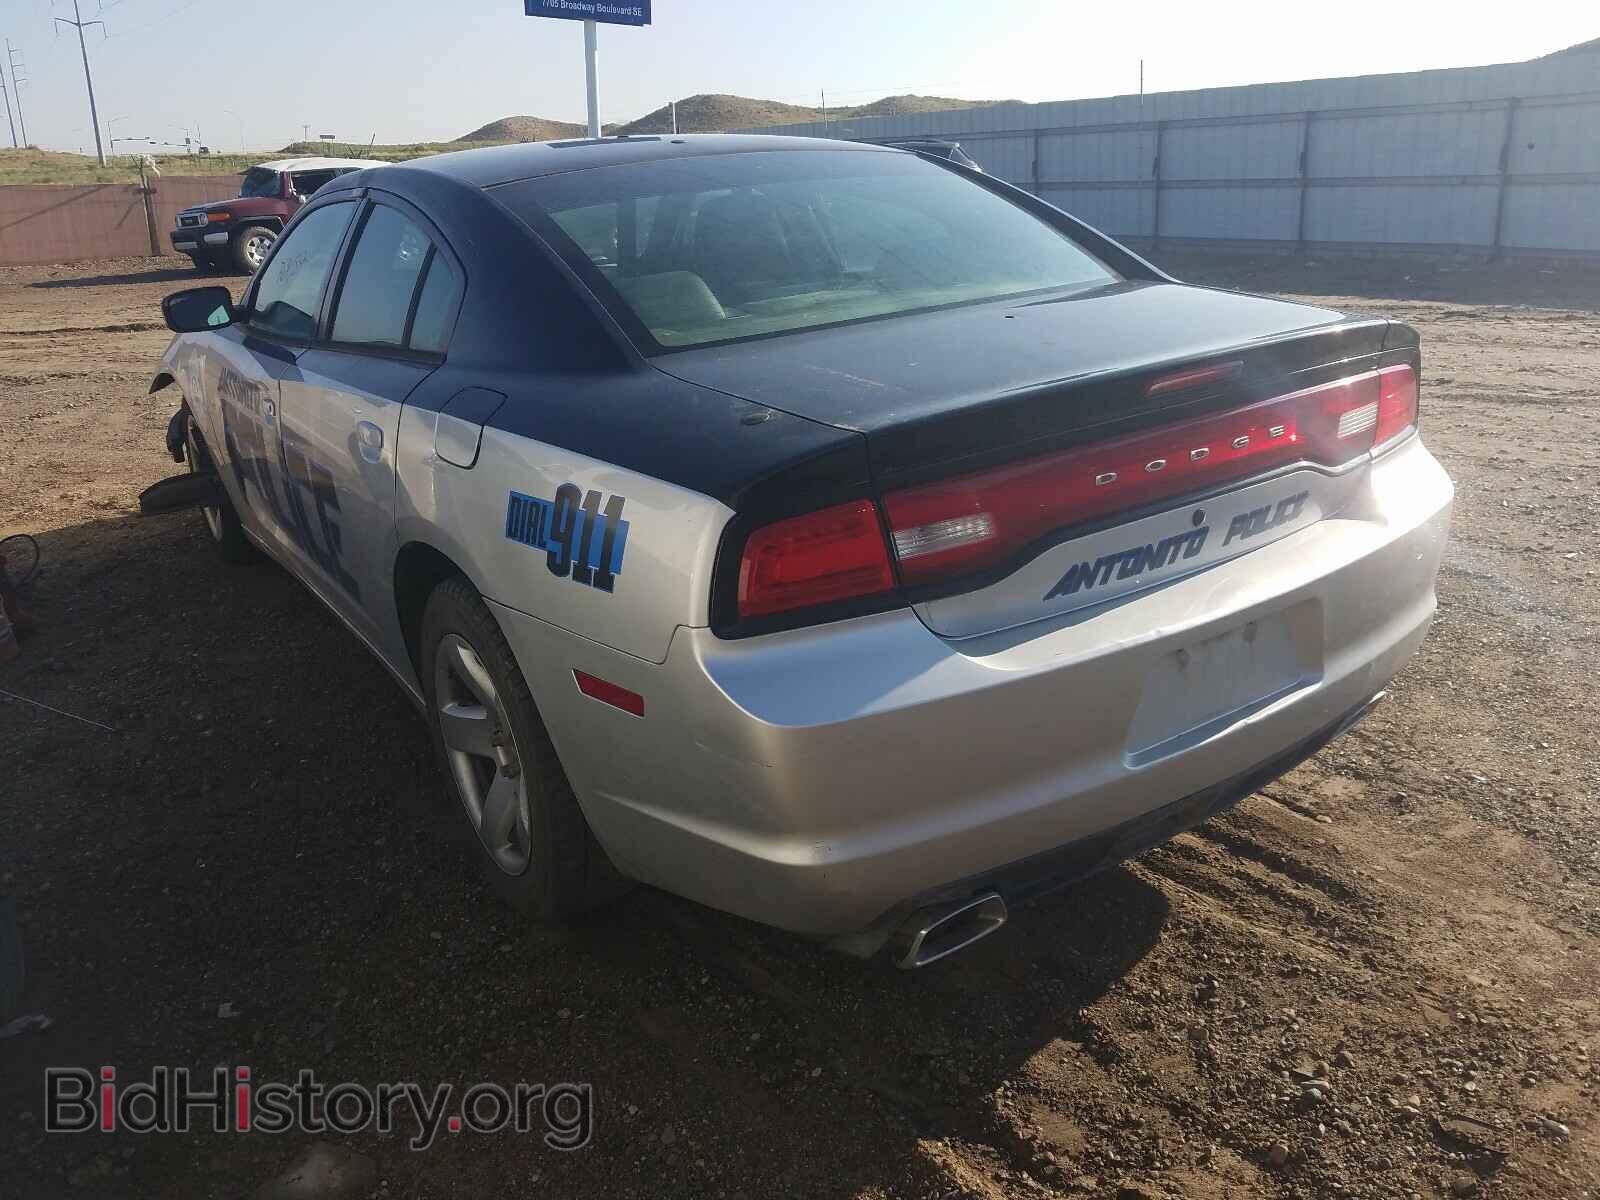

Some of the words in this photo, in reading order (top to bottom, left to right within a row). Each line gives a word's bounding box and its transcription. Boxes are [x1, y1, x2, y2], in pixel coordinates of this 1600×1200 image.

[560, 0, 595, 13] Broadway
[597, 3, 632, 15] Boulevard
[632, 7, 643, 16] SE
[1095, 425, 1285, 486] DODGE
[506, 493, 549, 550] DIAL
[546, 482, 626, 594] 911
[1043, 527, 1210, 602] ANTONITO
[1222, 490, 1309, 547] POLICE
